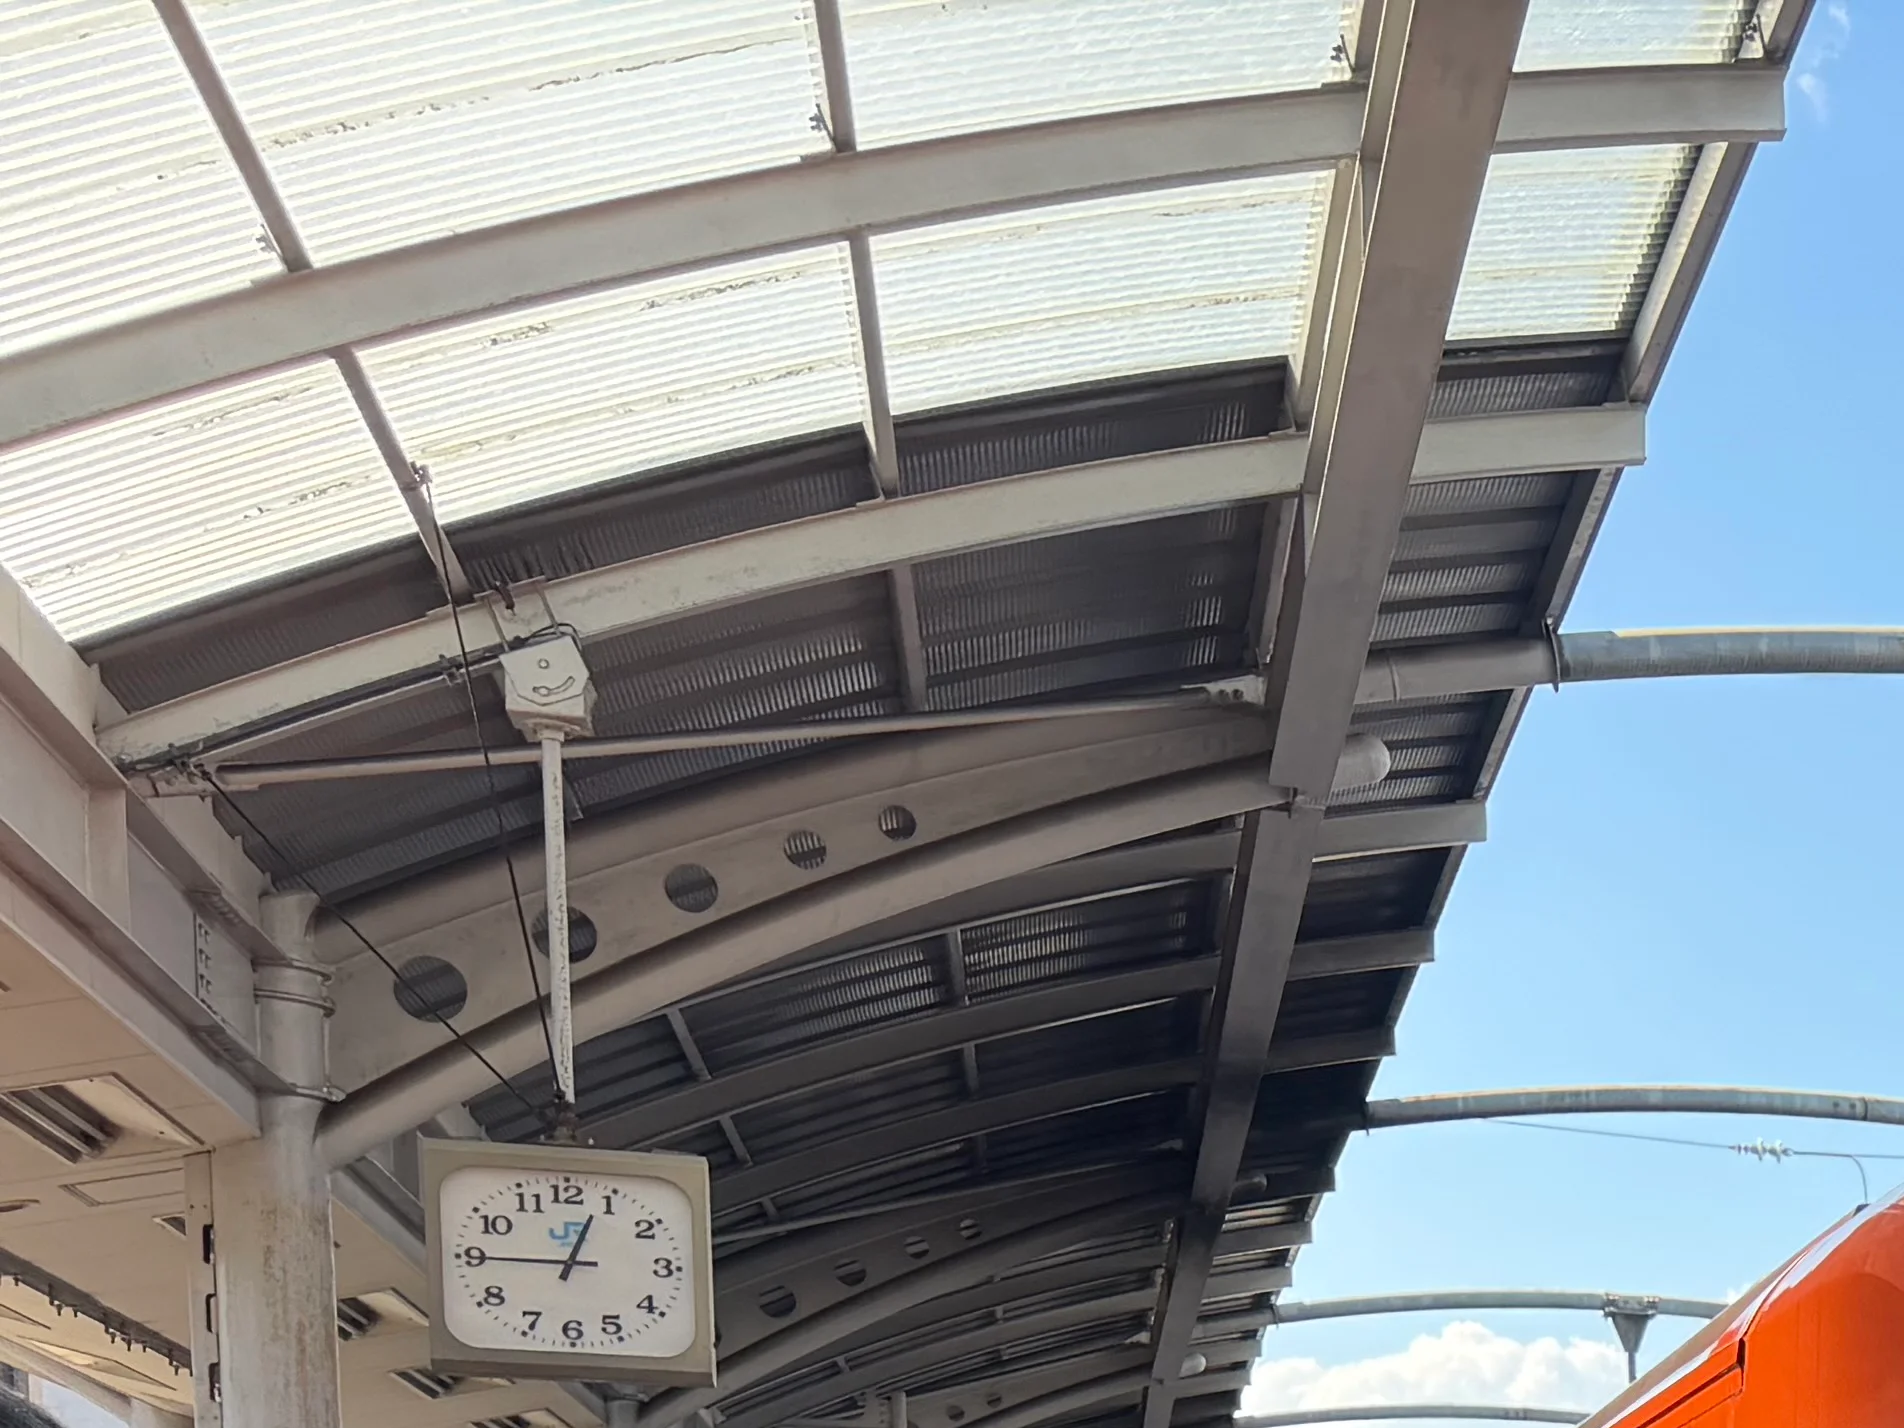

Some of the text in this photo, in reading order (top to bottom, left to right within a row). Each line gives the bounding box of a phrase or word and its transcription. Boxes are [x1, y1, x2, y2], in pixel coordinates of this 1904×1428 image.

[515, 1192, 545, 1214] 11
[550, 1184, 584, 1205] 12
[602, 1195, 616, 1216] 1
[480, 1215, 513, 1236] 10
[634, 1219, 656, 1240] 2
[464, 1246, 486, 1268] 9
[652, 1257, 674, 1278] 3
[483, 1285, 506, 1307] 8
[636, 1294, 658, 1314] 4
[522, 1311, 543, 1331] 7
[561, 1319, 584, 1340] 6
[601, 1314, 623, 1335] 5
